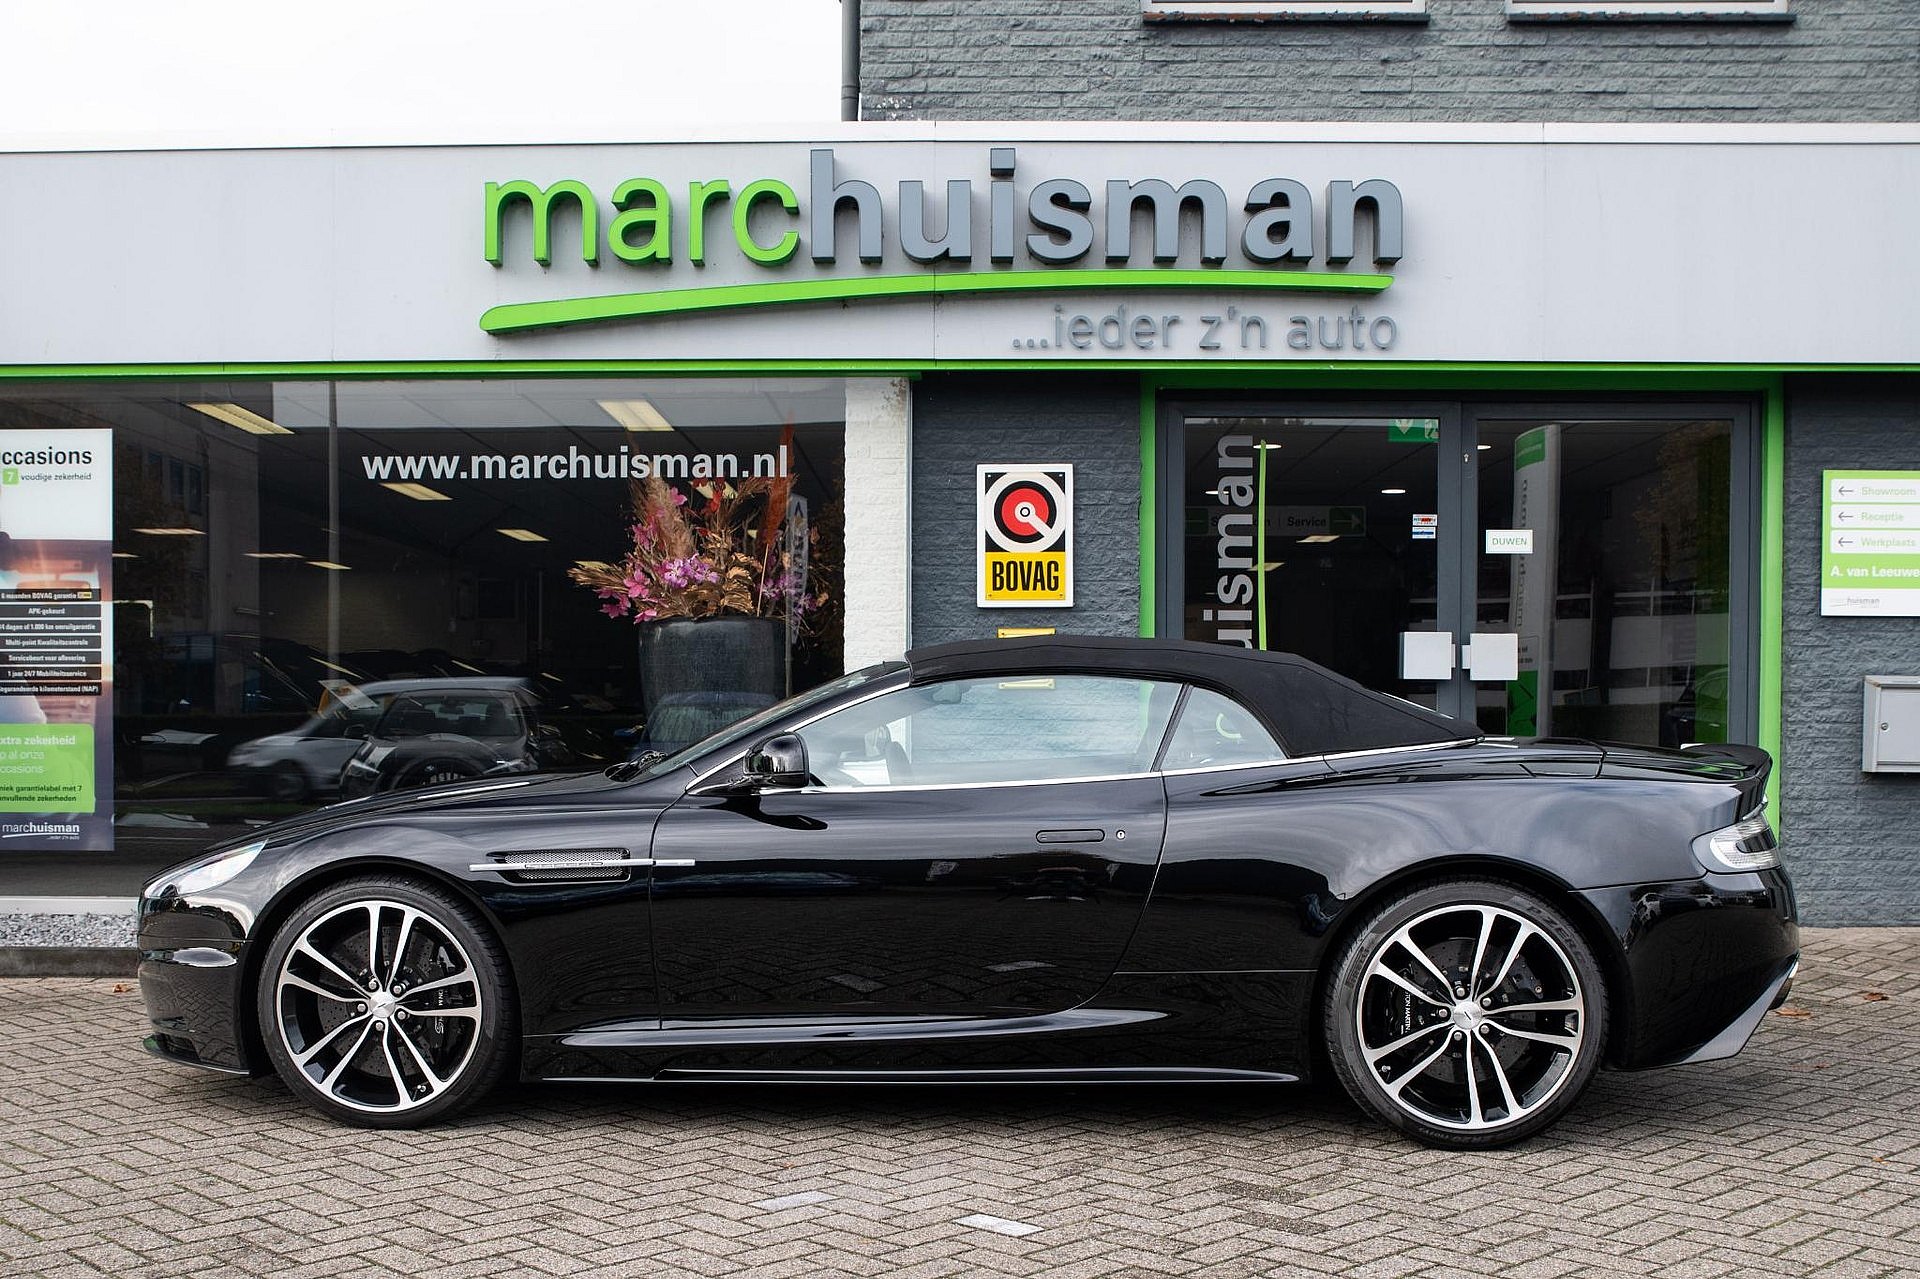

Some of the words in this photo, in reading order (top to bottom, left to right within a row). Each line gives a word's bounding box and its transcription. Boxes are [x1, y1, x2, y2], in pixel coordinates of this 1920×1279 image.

[484, 149, 1402, 267] marchuisman
[1199, 305, 1267, 350] z'n
[1287, 304, 1398, 350] auto
[2, 446, 92, 465] ccasions
[362, 445, 788, 479] www.marchuisman.nl
[7, 472, 14, 482] 7
[21, 473, 52, 482] voudige
[54, 472, 92, 481] zekerheid
[1861, 486, 1917, 496] Showroom
[1287, 516, 1327, 527] Service
[1860, 512, 1904, 523] Receptie
[1492, 537, 1527, 546] DUWEN
[1860, 537, 1916, 548] Werkplaats
[992, 560, 1059, 591] BOVAG
[1846, 567, 1869, 577] van
[24, 735, 76, 745] zekerheid
[16, 784, 60, 793] garantielabel
[2, 822, 80, 833] marchuisman
